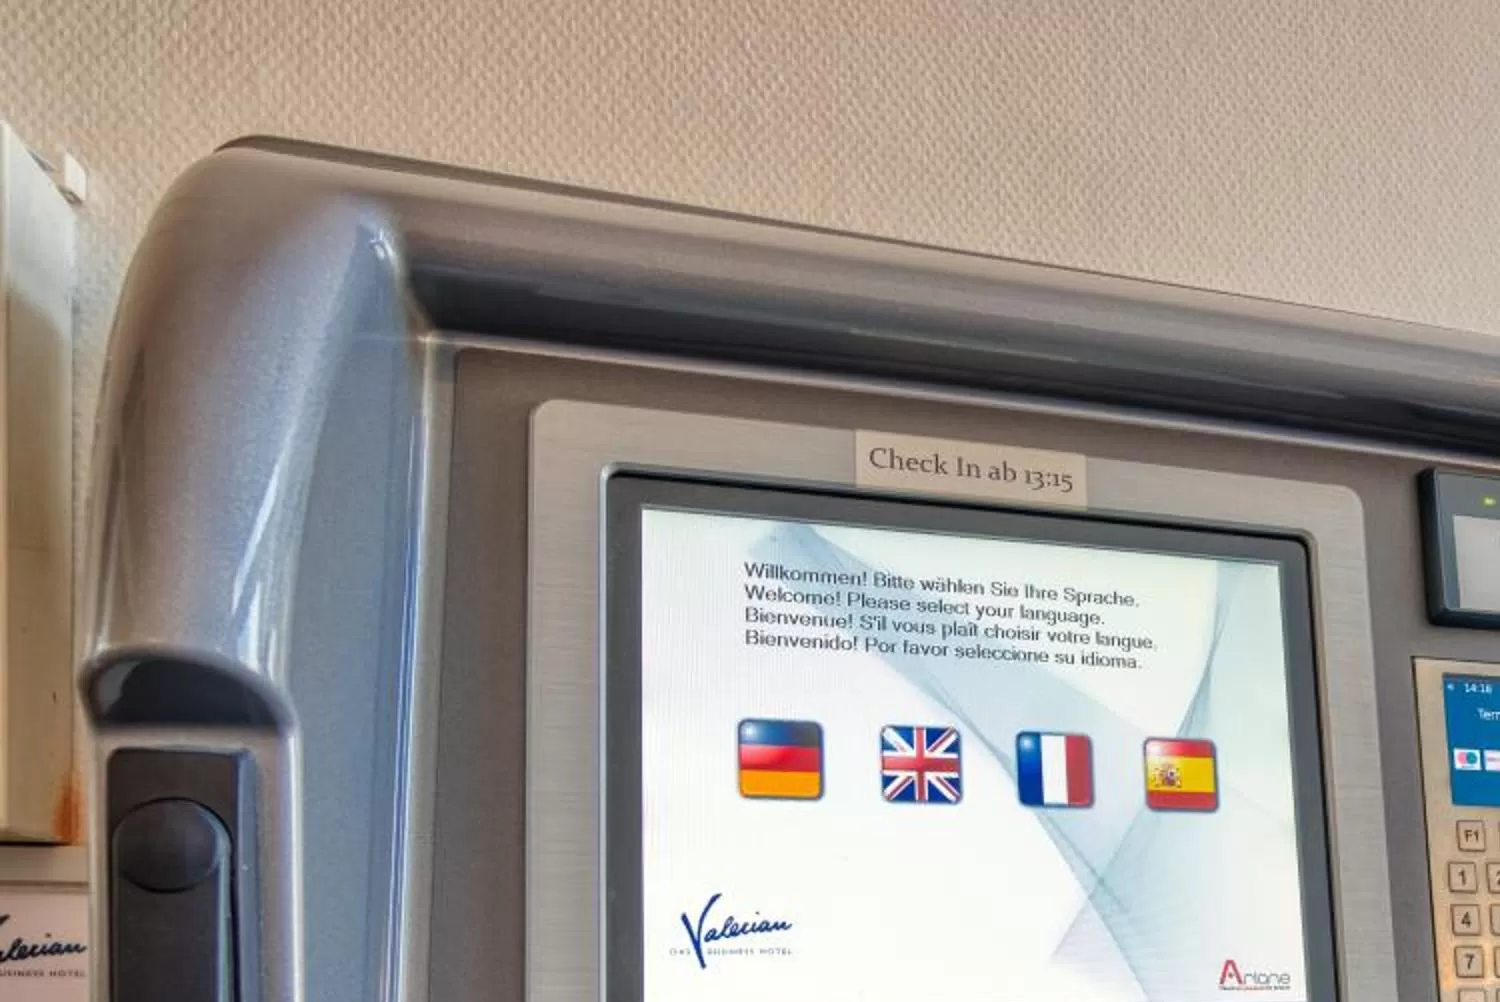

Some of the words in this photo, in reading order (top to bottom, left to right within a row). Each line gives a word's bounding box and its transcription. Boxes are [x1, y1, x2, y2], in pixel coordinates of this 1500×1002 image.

[869, 447, 948, 475] Check
[956, 456, 981, 479] In
[988, 460, 1017, 482] ab
[1023, 468, 1073, 493] 13:15
[744, 561, 868, 587] Willkommen!
[873, 571, 915, 590] Bitte
[919, 576, 985, 596] wählen
[991, 580, 1019, 598] Sie
[1025, 583, 1058, 601] Ihre
[744, 584, 841, 608] Welcome!
[847, 591, 911, 612] Please
[916, 599, 969, 617] select
[976, 604, 1014, 621] your
[1019, 603, 1105, 628] language.
[744, 606, 854, 630] Bienvenue!
[859, 614, 888, 632] S'il
[892, 620, 937, 635] vous
[941, 621, 978, 641] plaît
[983, 624, 1040, 642] choisir
[1047, 629, 1091, 645] votre
[744, 629, 859, 653] Bienvenido!
[865, 637, 898, 655] Por
[903, 640, 950, 658] favor
[954, 642, 1049, 664] seleccione
[1054, 651, 1075, 665] su
[1080, 650, 1144, 670] idioma.
[1464, 829, 1479, 843] F1
[1458, 869, 1467, 885] 1
[681, 892, 793, 970] Valerian
[1461, 911, 1472, 928] 4
[1465, 953, 1475, 971] 7
